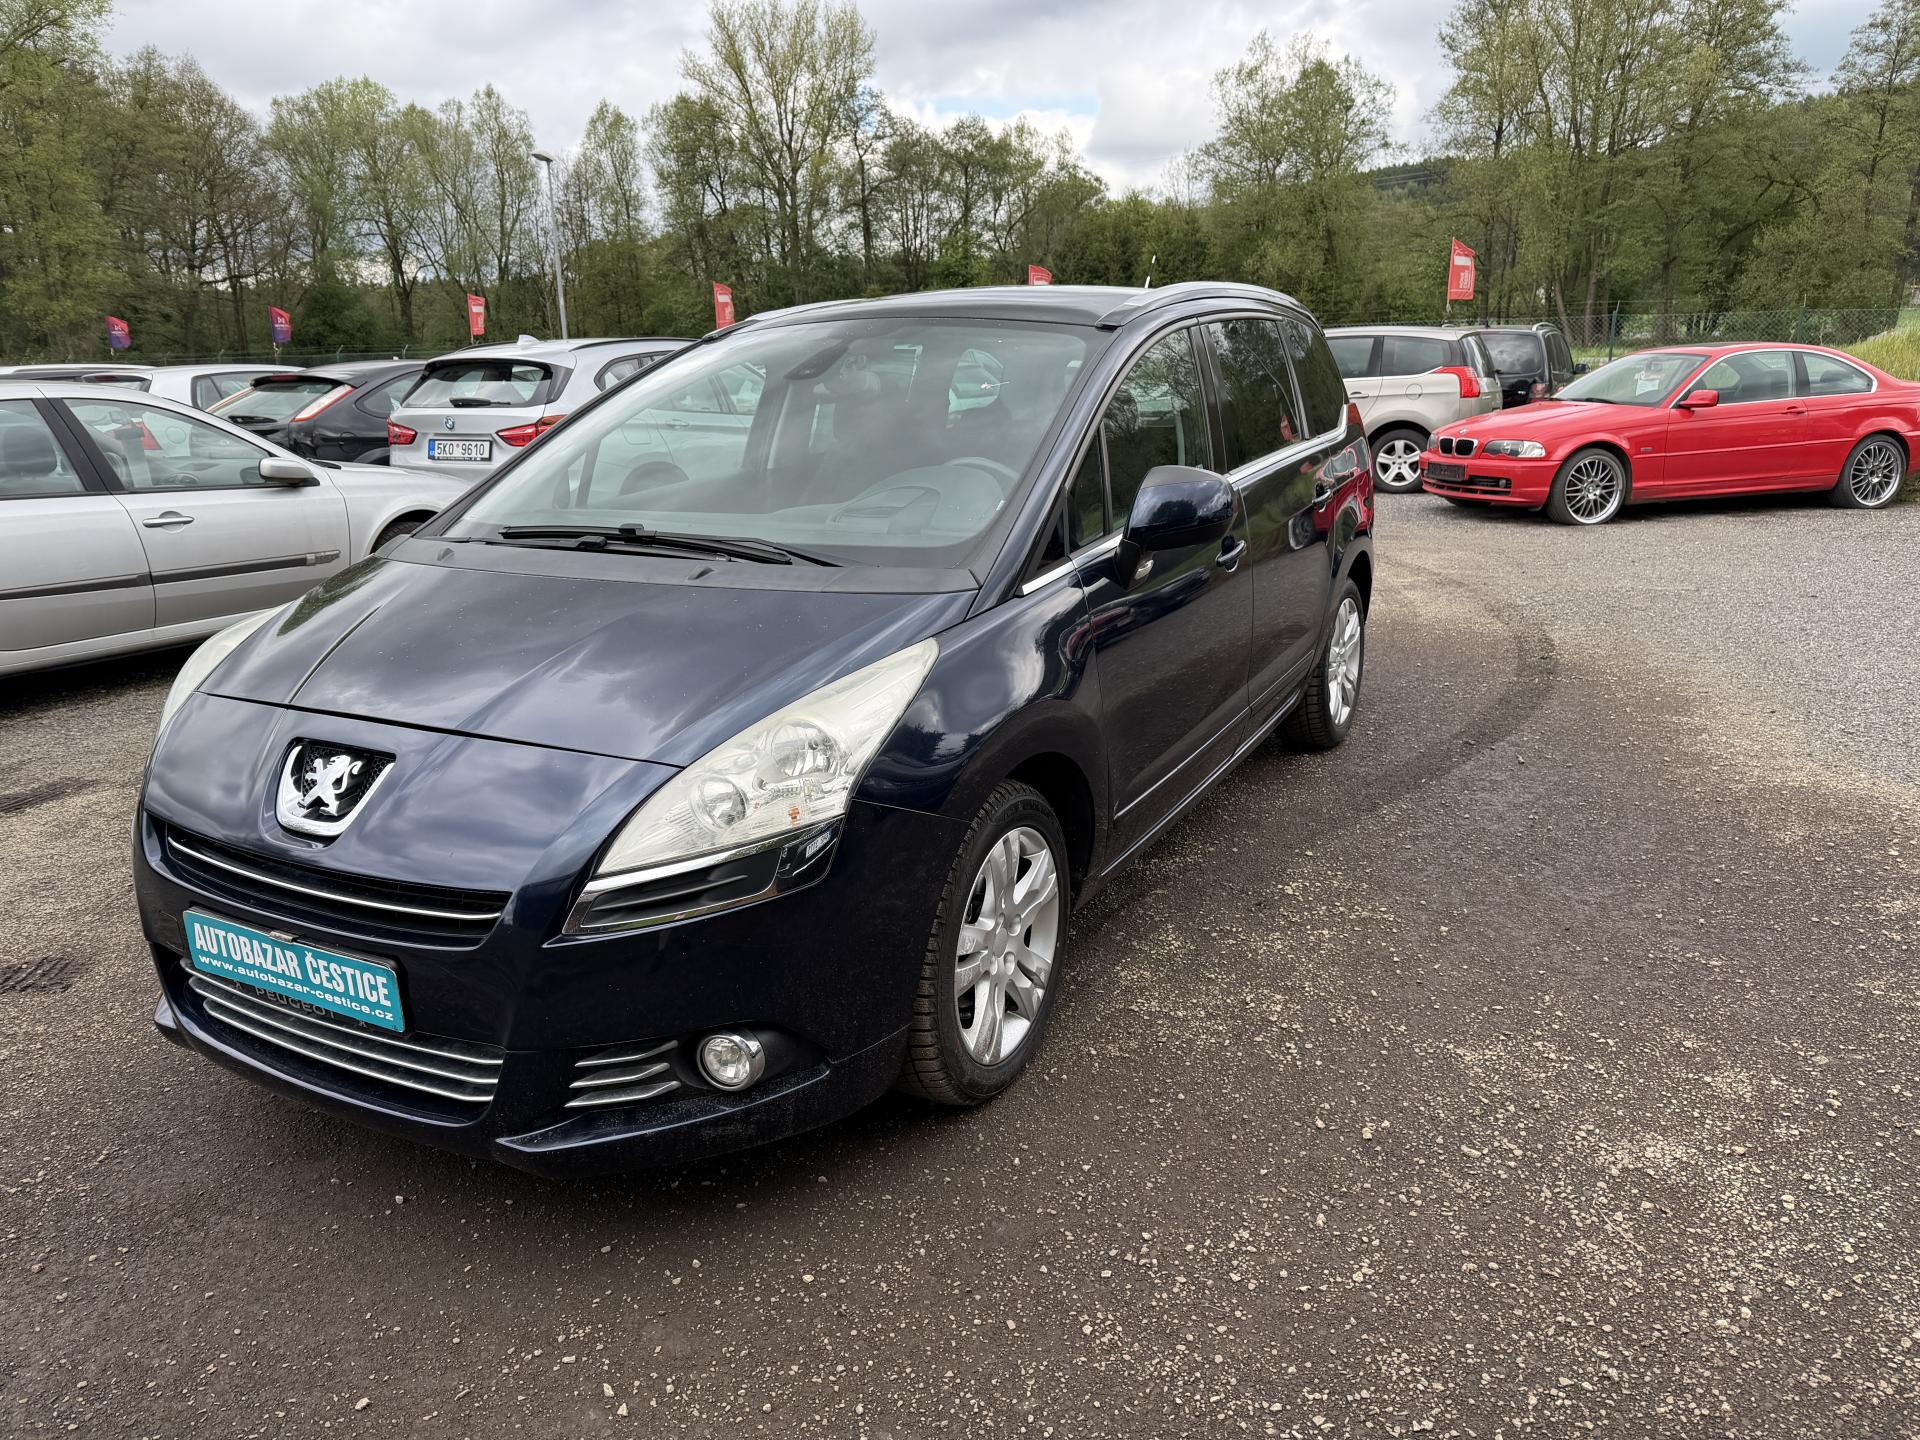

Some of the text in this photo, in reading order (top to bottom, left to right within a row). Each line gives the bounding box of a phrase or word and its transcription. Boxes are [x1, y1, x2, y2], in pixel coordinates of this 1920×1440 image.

[461, 443, 485, 456] 9610
[193, 922, 392, 1007] AUTOBAZAR ČESTICE
[198, 954, 394, 1021] www.autobazar-cestice.cz
